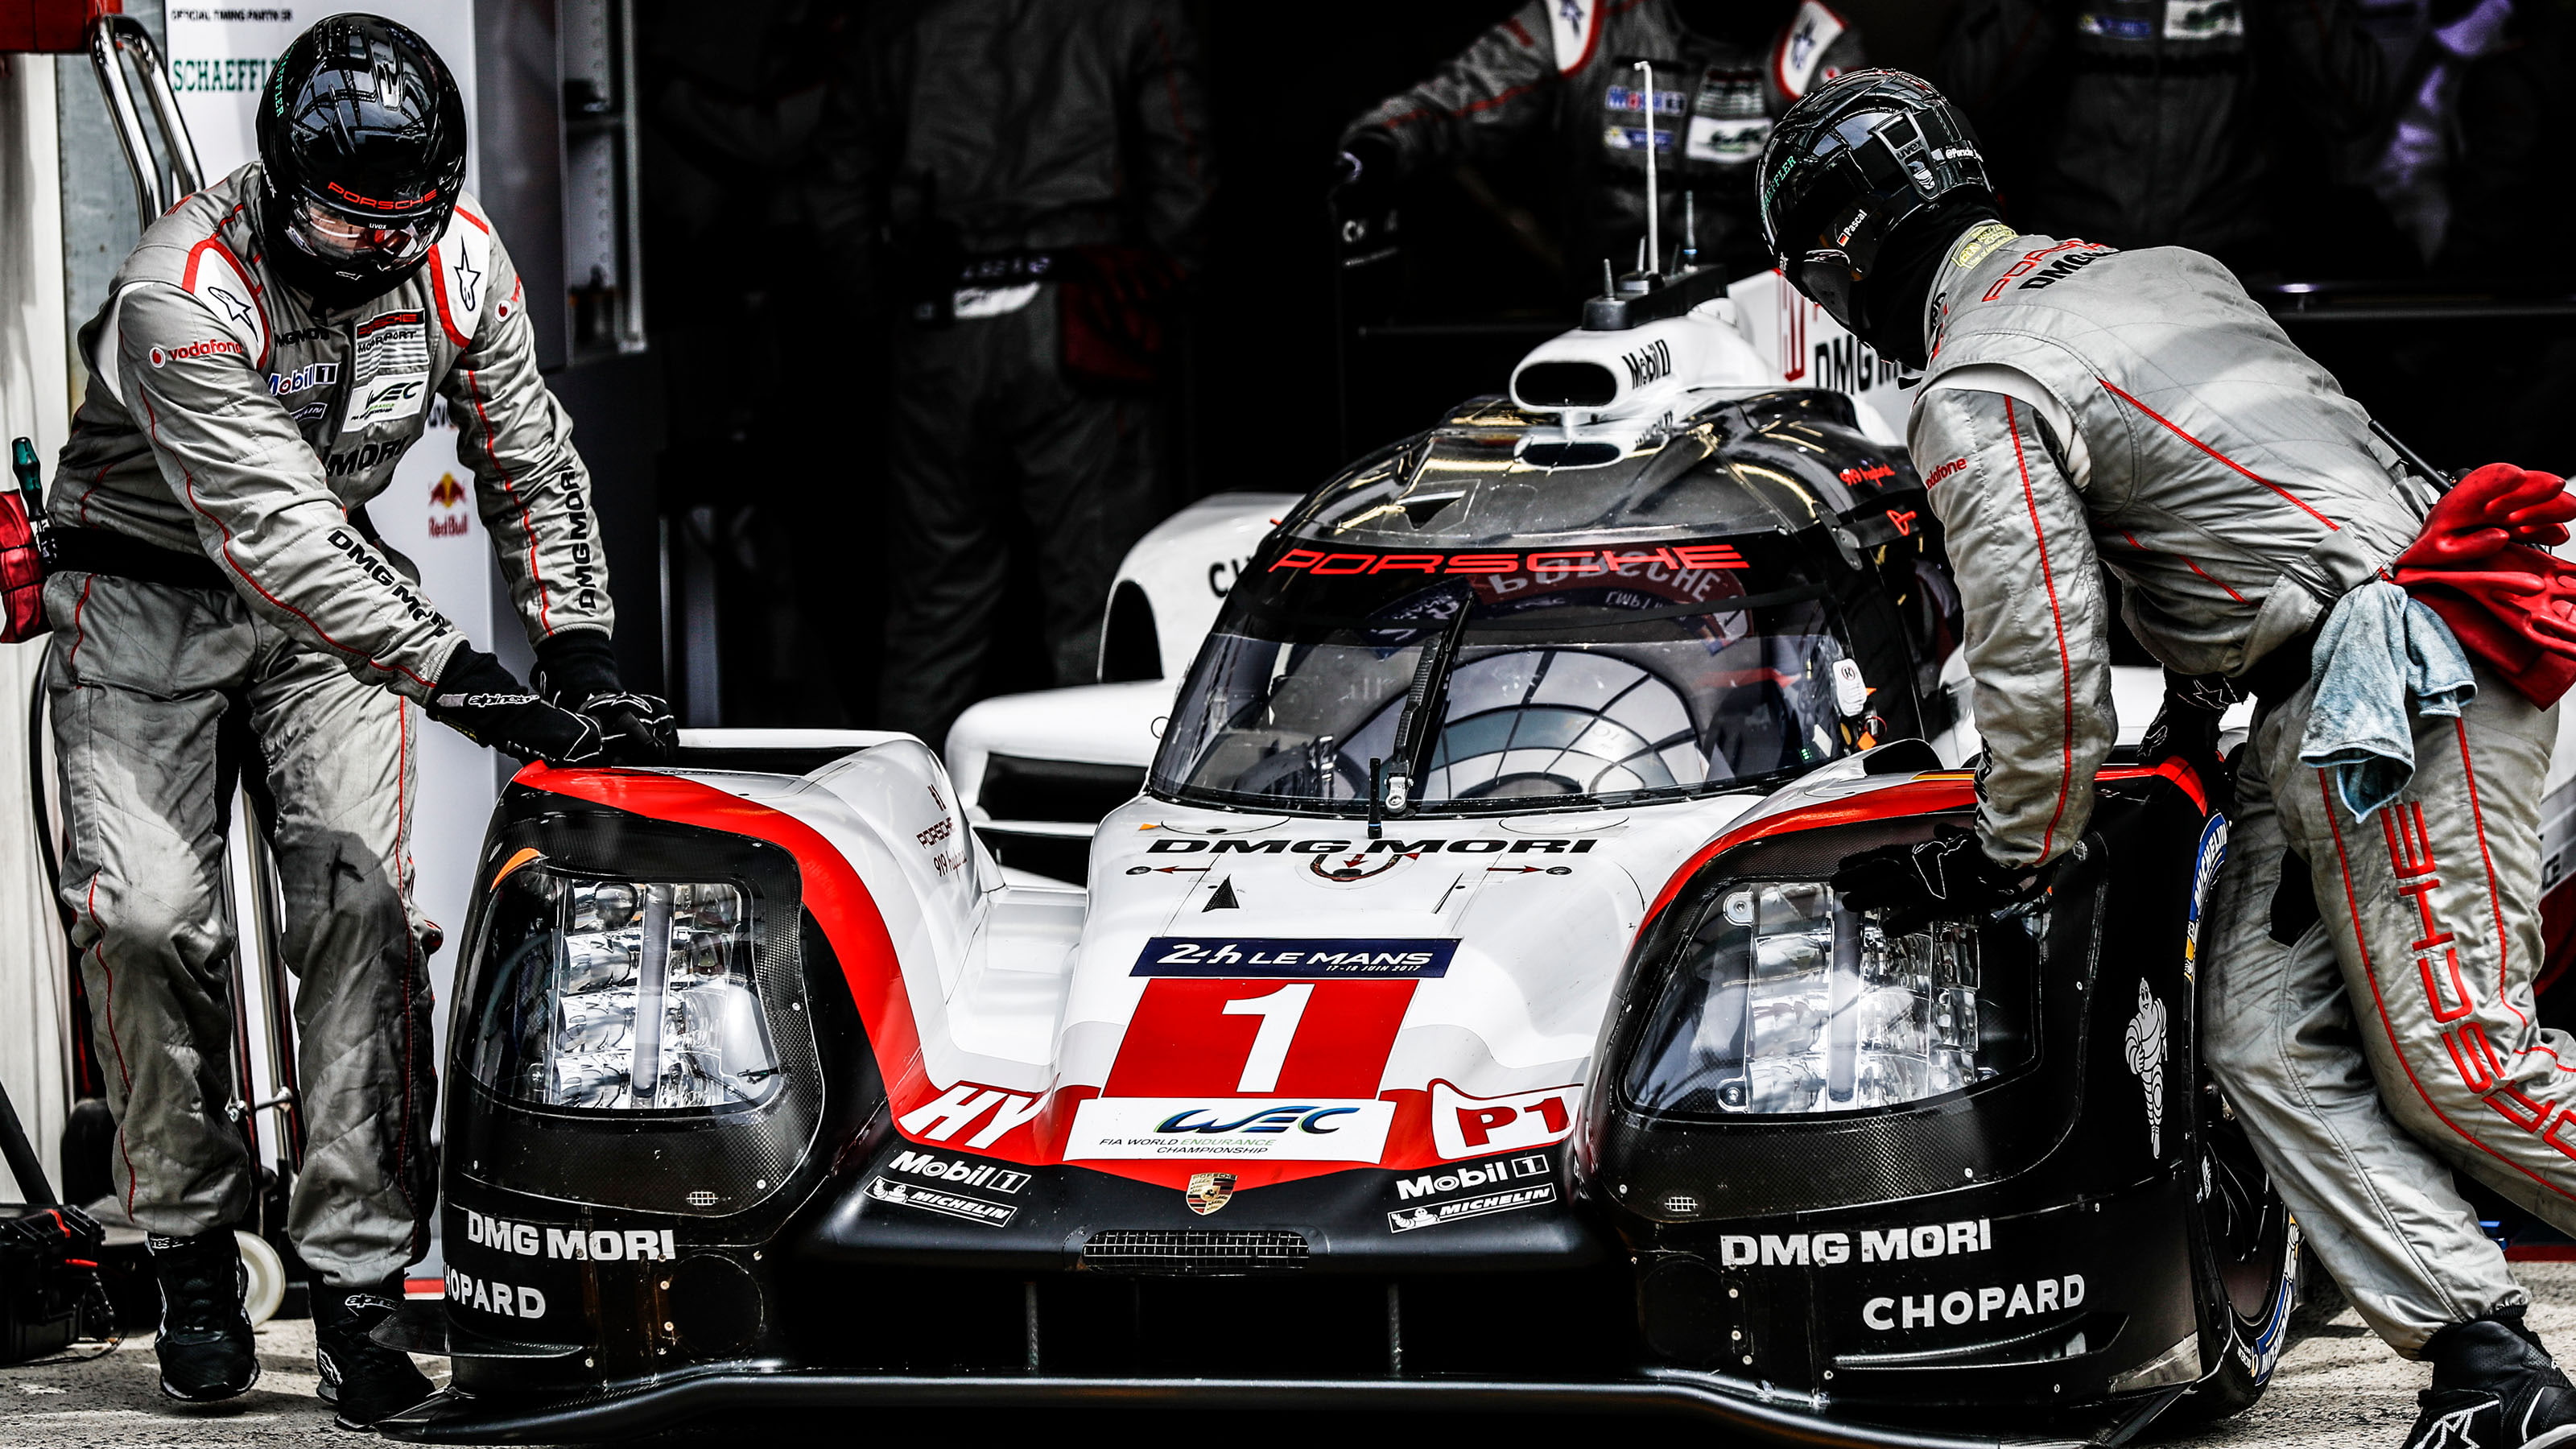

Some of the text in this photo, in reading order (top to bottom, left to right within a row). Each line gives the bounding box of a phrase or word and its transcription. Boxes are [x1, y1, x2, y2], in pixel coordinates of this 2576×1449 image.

[172, 59, 277, 92] SCHAEFFL
[328, 182, 437, 210] PORSCHE
[369, 222, 387, 230] uvex
[1843, 208, 1868, 237] Pascal
[2017, 254, 2098, 290] DMG
[1925, 457, 1967, 490] odafone
[327, 530, 395, 586] DMG
[572, 543, 597, 609] DMG
[1267, 544, 1751, 576] PORSCHE
[933, 853, 948, 877] 919
[1146, 839, 1599, 855] DMG MORI
[1248, 952, 1304, 965] LE
[1307, 952, 1434, 965] MANS
[2379, 802, 2576, 1162] ORSCHE
[1221, 984, 1315, 1093] 1
[898, 1073, 1059, 1150] HY
[1154, 1105, 1360, 1134] WEC
[1455, 1096, 1571, 1148] P1
[889, 1150, 997, 1187] Mobil
[1396, 1161, 1509, 1201] Mobil
[910, 1191, 1010, 1220] MICHELIN
[1439, 1187, 1551, 1217] MICHELIN
[468, 1210, 676, 1261] DMG MORI
[1719, 1218, 1991, 1266] DMG MORI
[444, 1261, 547, 1319] HOPARD
[1863, 1274, 2085, 1331] CHOPARD
